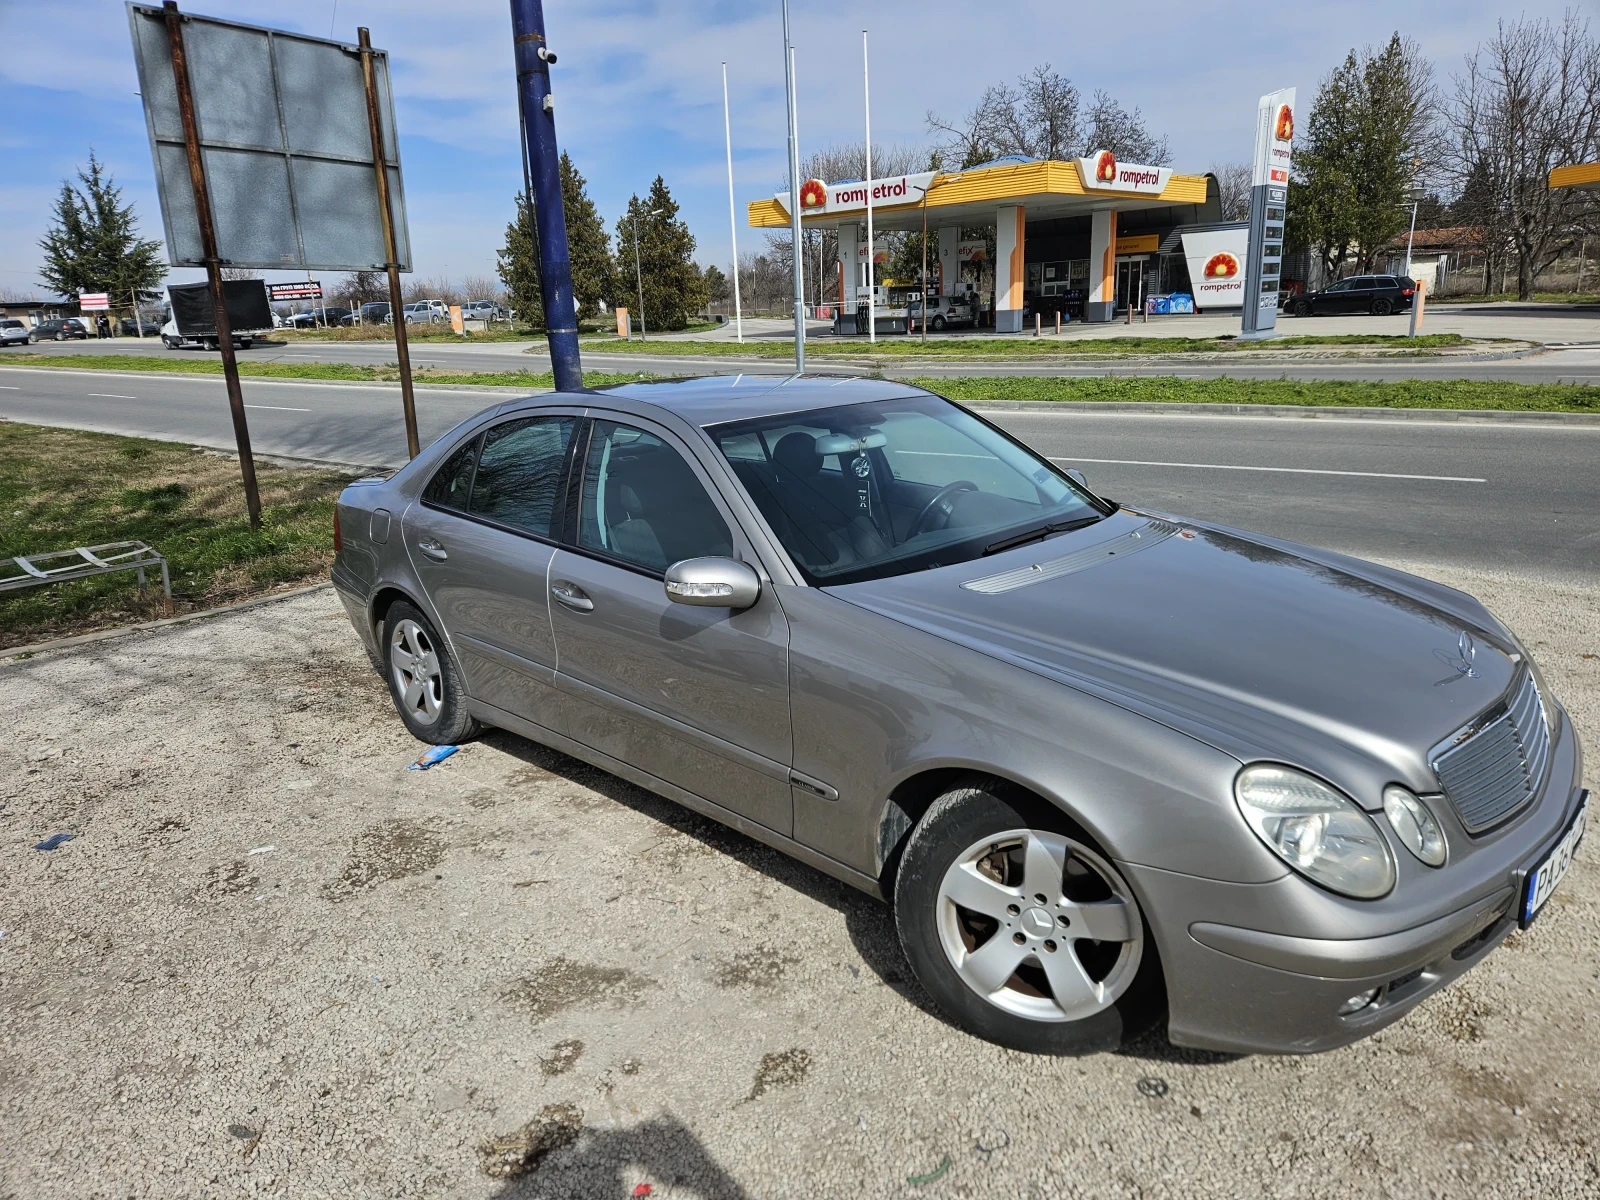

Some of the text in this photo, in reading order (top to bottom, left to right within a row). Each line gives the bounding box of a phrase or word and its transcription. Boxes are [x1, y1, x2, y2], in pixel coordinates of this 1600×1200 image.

[1119, 169, 1160, 189] rompetrol
[836, 178, 906, 206] rompetrol
[844, 251, 848, 259] 1
[944, 249, 950, 257] 3
[958, 245, 975, 256] efix
[1200, 281, 1242, 292] rompetrol
[892, 320, 896, 329] 1
